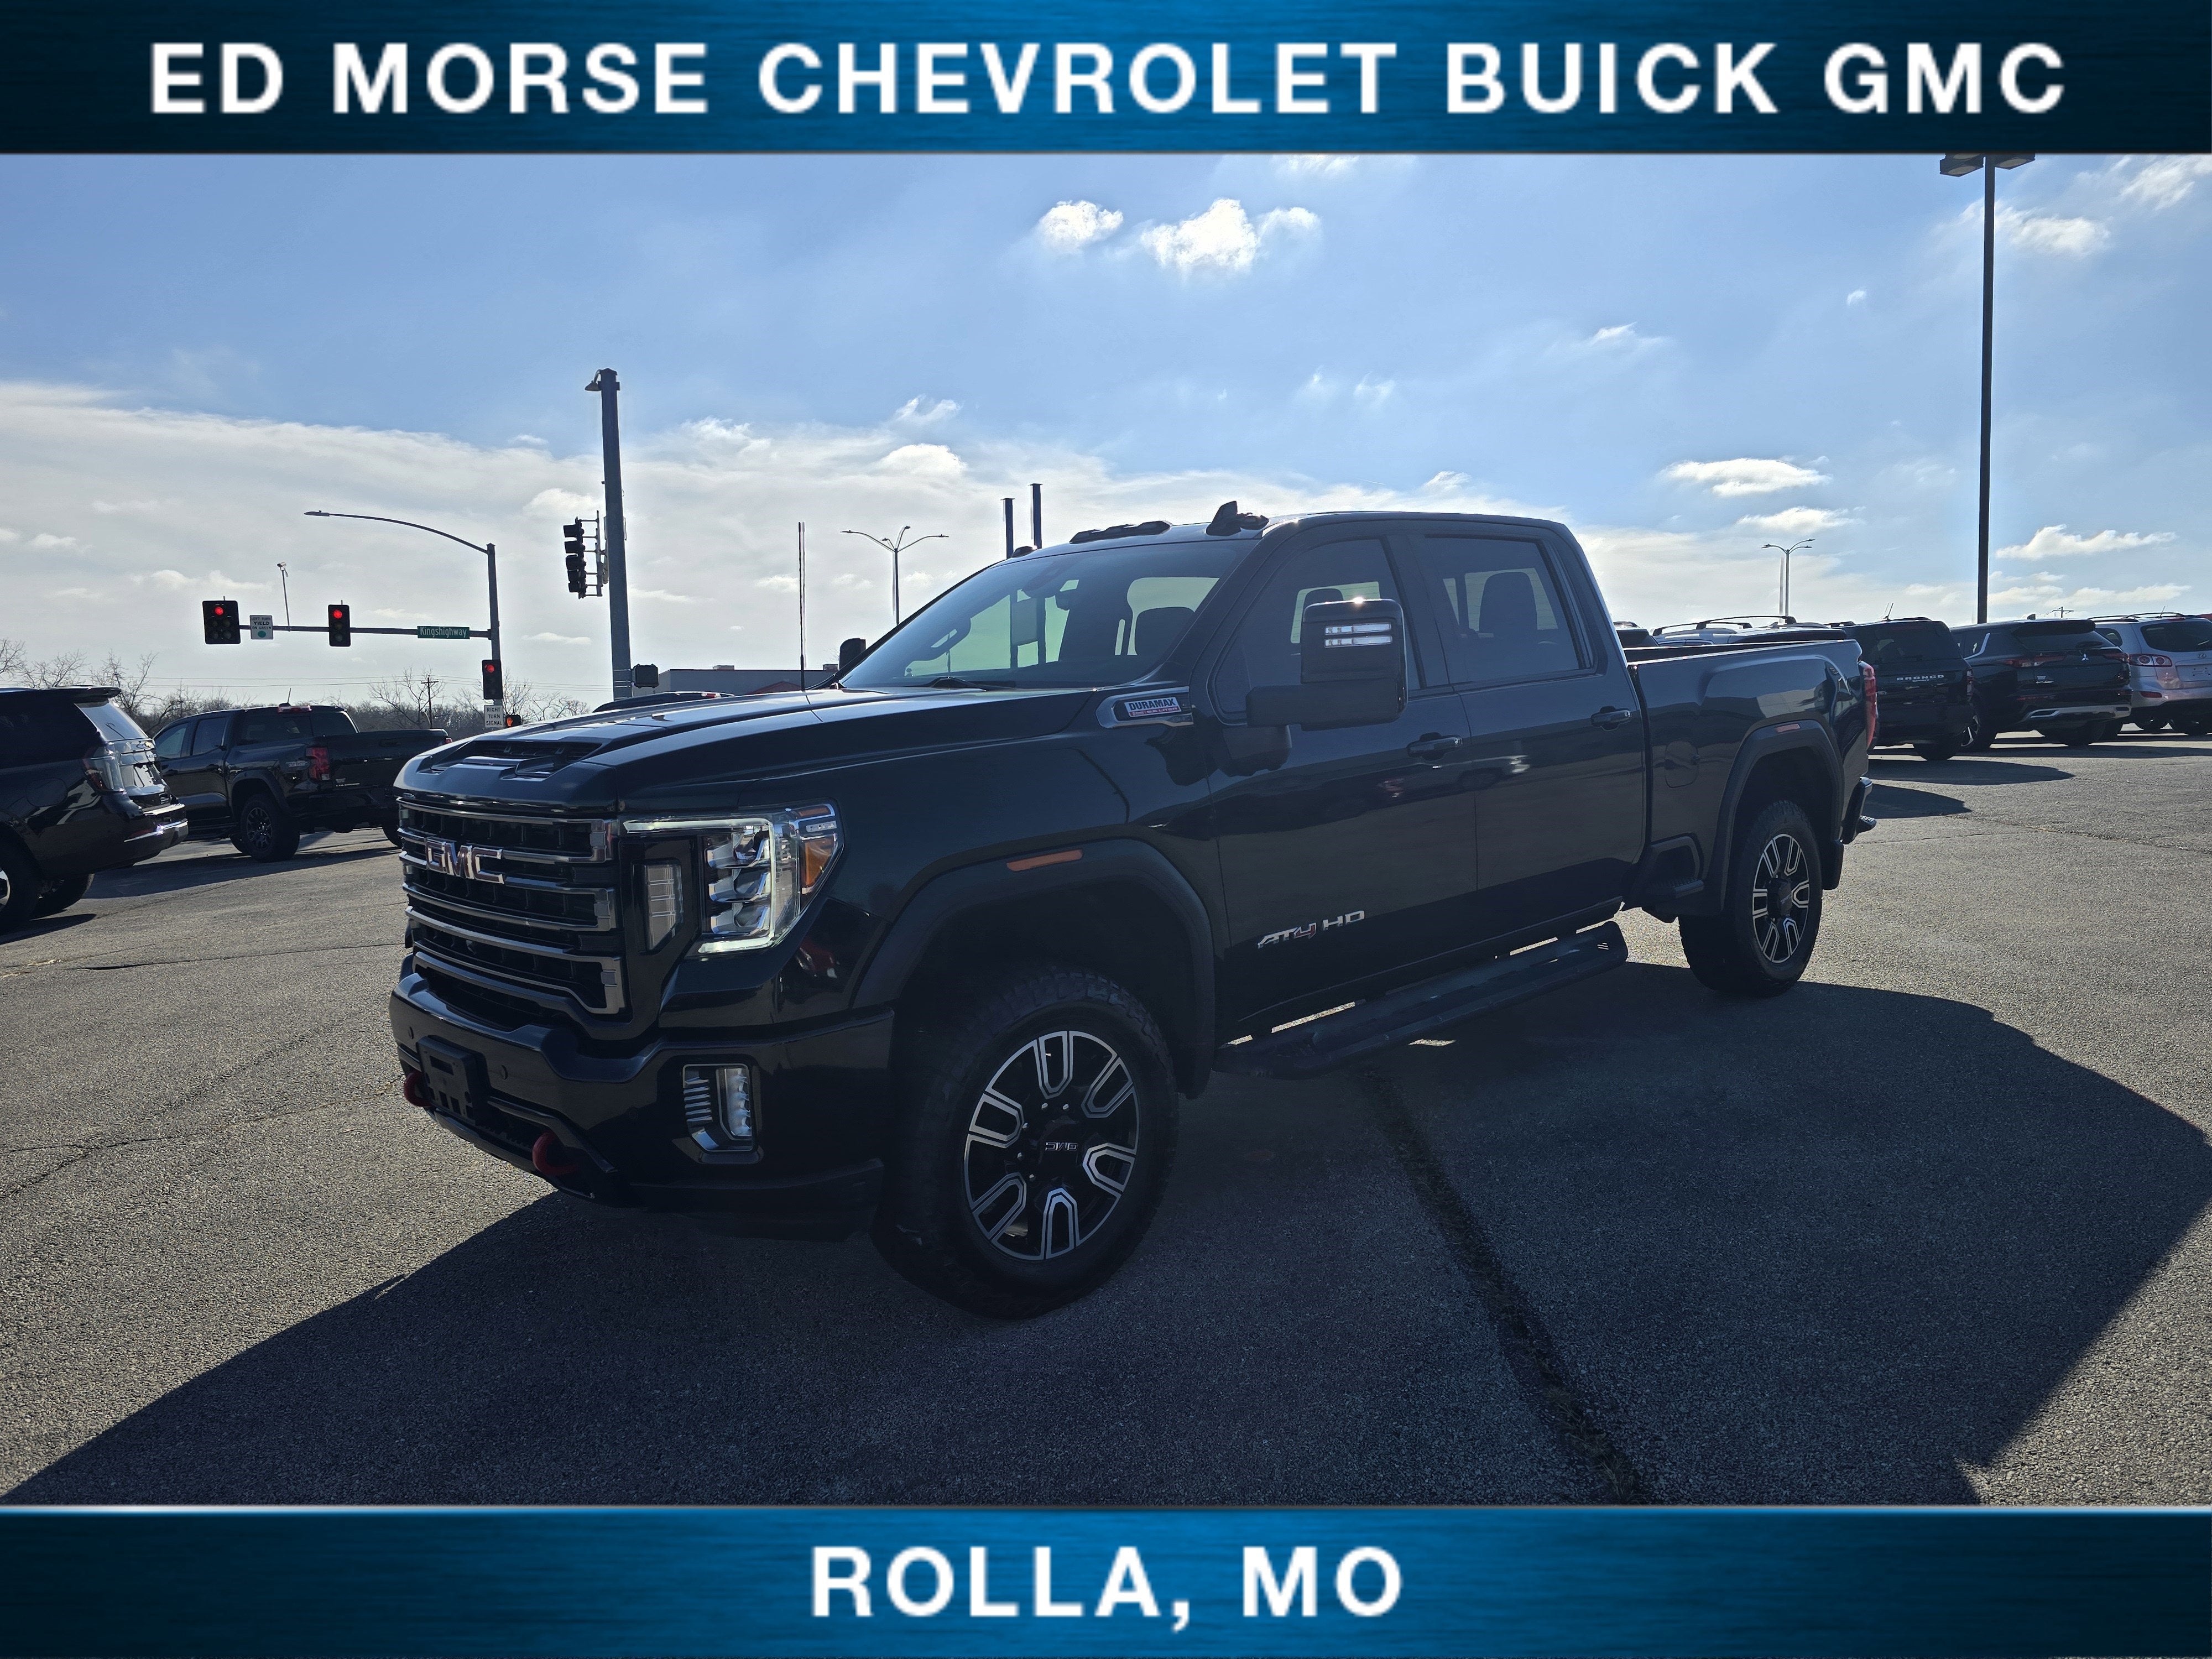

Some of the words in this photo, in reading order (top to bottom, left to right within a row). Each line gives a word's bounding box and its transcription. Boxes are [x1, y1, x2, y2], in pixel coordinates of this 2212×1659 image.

[420, 626, 467, 638] Kingshighway
[1128, 698, 1176, 711] DURAMAX
[425, 837, 504, 884] GMC
[1257, 922, 1317, 948] AT4
[1322, 910, 1365, 930] HD
[1045, 1142, 1078, 1151] GMC
